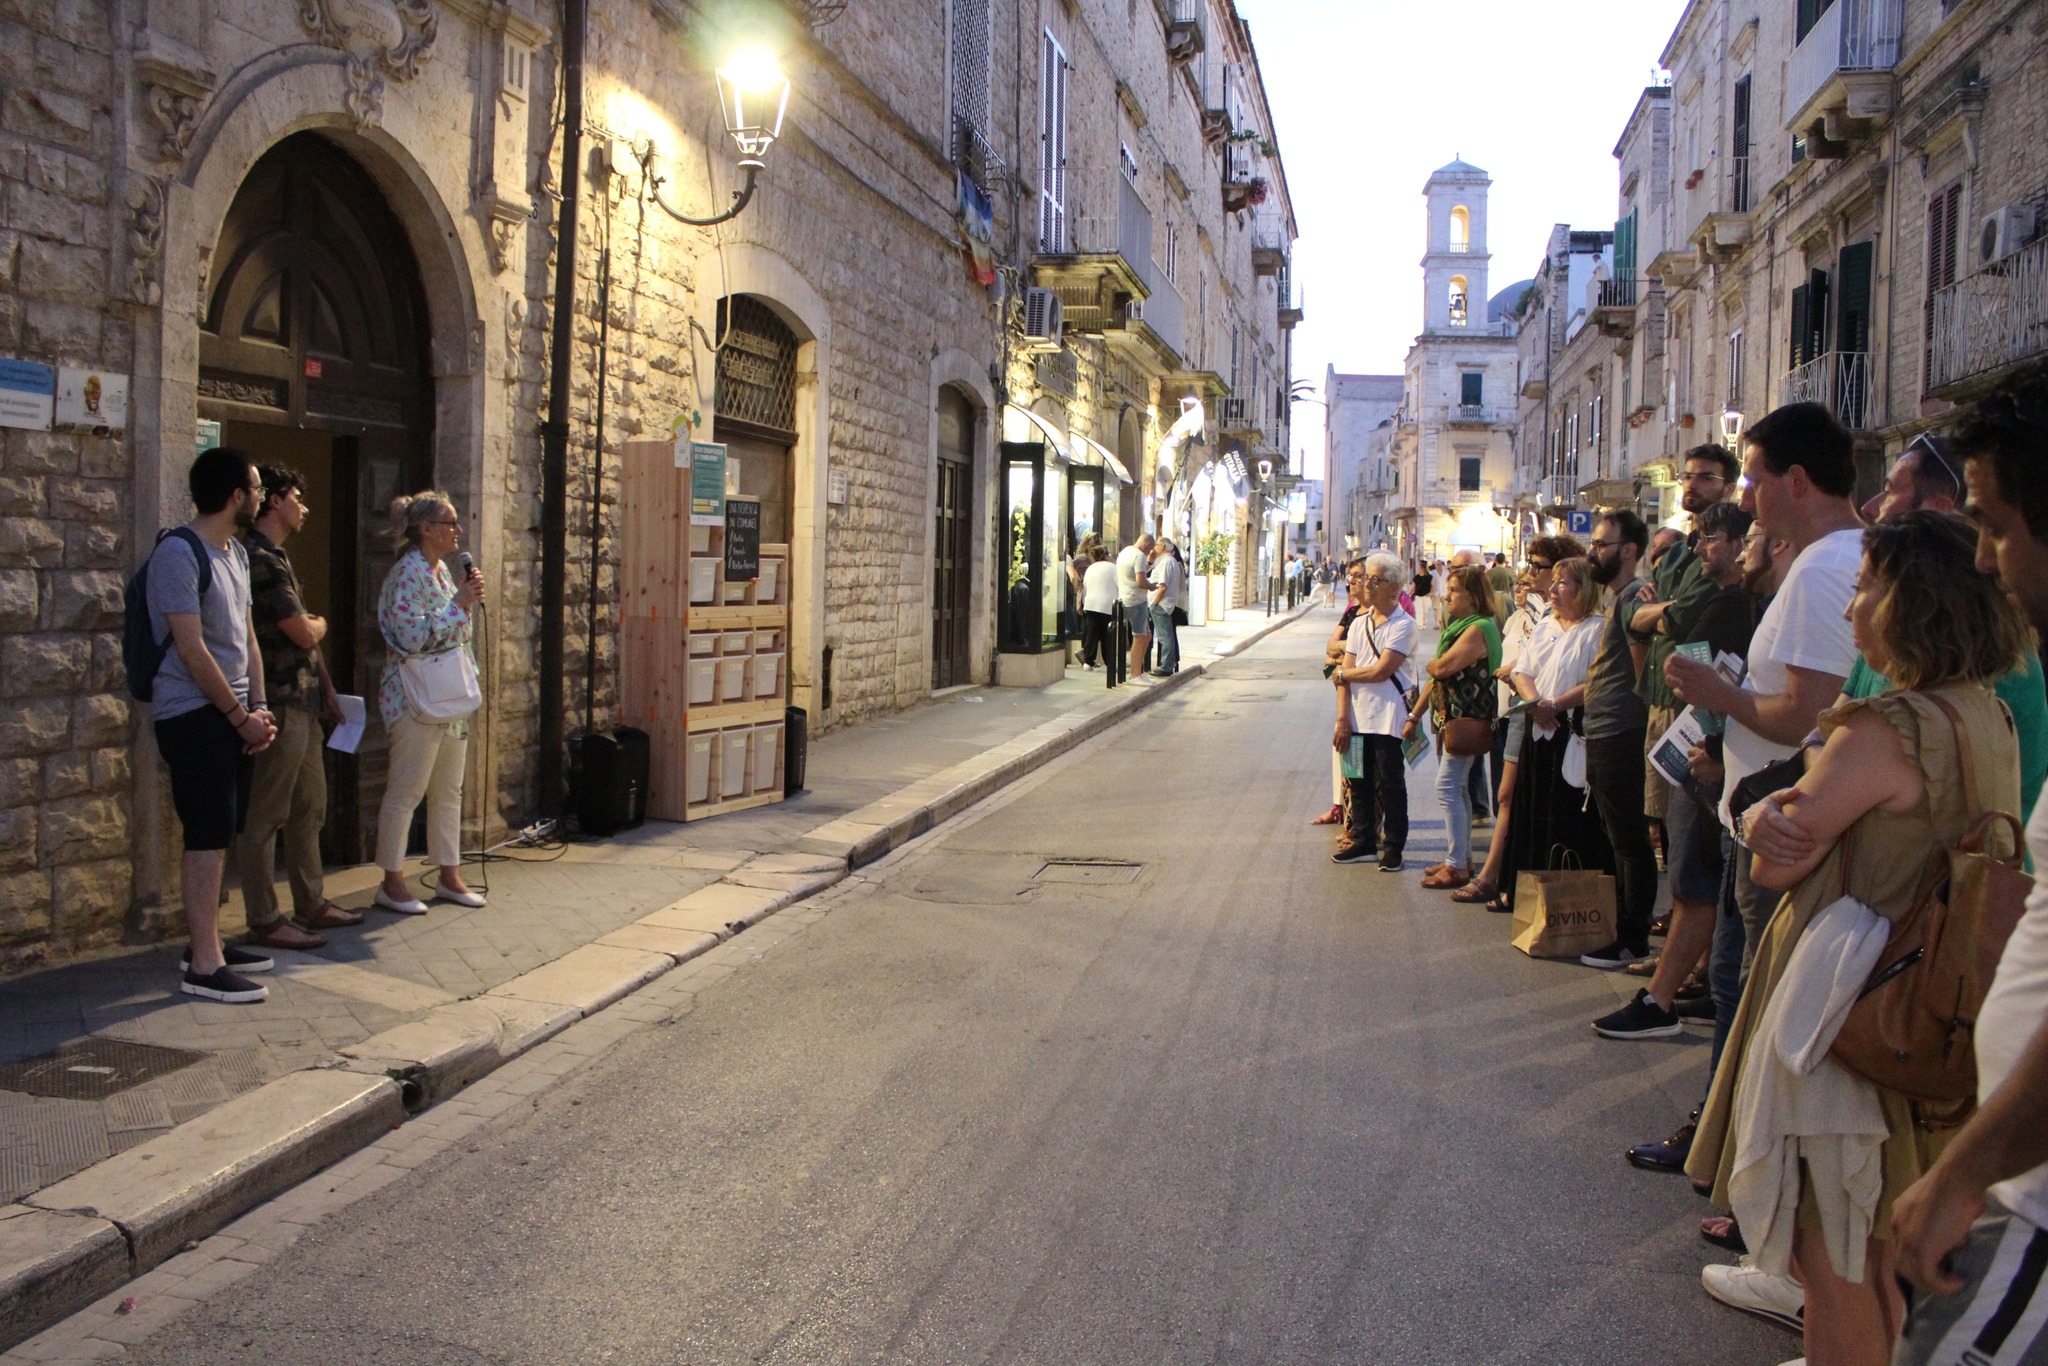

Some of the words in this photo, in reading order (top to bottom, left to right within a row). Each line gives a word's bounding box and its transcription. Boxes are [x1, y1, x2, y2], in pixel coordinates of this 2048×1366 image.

[528, 202, 538, 219] 6
[1232, 450, 1247, 477] FRATELLI
[1572, 513, 1587, 531] P
[1548, 910, 1601, 928] DIVINO
